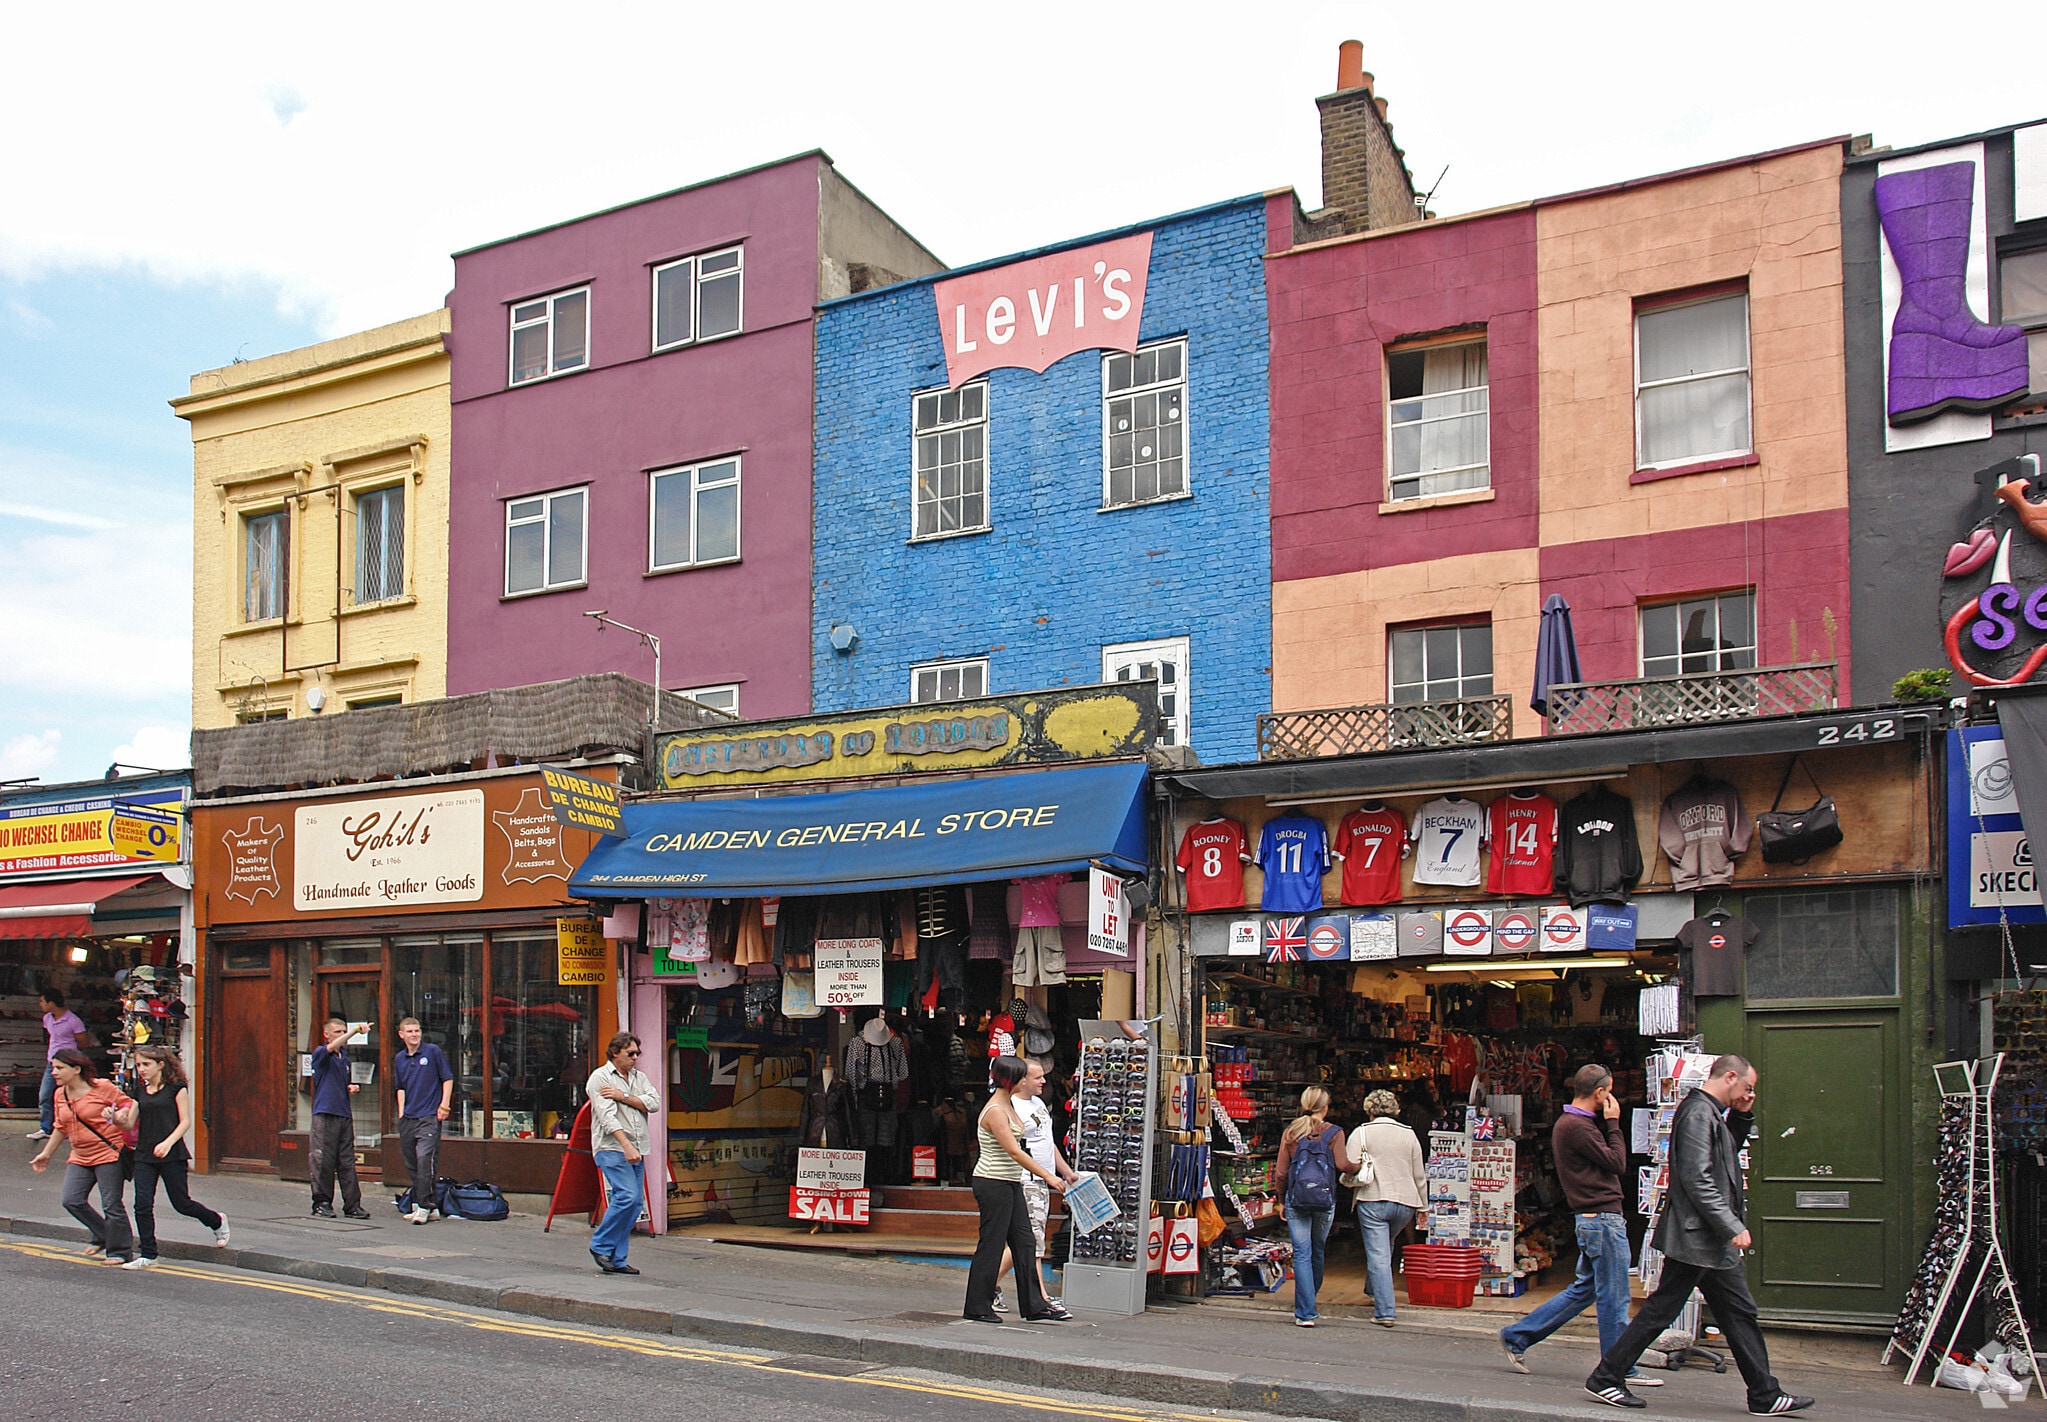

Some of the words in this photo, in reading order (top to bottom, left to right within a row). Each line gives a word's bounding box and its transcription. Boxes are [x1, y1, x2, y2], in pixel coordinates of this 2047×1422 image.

[1817, 718, 1896, 746] 242
[543, 769, 615, 802] BUREAU
[9, 809, 30, 818] BUREAU
[30, 808, 38, 816] DE
[37, 806, 60, 816] CHANGE
[64, 803, 85, 812] CHEQUE
[550, 791, 570, 806] DE
[573, 796, 621, 818] CHANGE
[509, 813, 557, 825] Handcrafte
[1508, 808, 1539, 819] HENRY
[1679, 804, 1726, 831] OXFORD
[115, 818, 142, 829] CAMBIO
[567, 809, 616, 831] CAMBIO
[1424, 815, 1478, 831] BECKHAM
[12, 822, 58, 847] WECHSEL
[61, 819, 103, 843] CHANGE
[115, 826, 148, 837] WECHSEL
[519, 825, 551, 836] Sandals
[645, 829, 772, 852] CAMDEN
[776, 818, 926, 847] GENERAL
[935, 804, 1060, 832] STORE
[1352, 825, 1393, 837] RONALDO
[1576, 819, 1615, 836] LONDON
[115, 833, 143, 843] CHANGE
[341, 806, 434, 862] Gohil's
[1275, 829, 1307, 842] DROGBA
[1505, 821, 1538, 856] 14
[237, 838, 269, 848] Makers
[1193, 834, 1231, 848] ROONEY
[1439, 828, 1464, 863] 7
[531, 849, 538, 857] &
[1276, 842, 1302, 874] 11
[1364, 837, 1383, 869] 7
[6, 858, 15, 870] &
[16, 856, 57, 869] Fashion
[236, 856, 268, 865] Quality
[386, 857, 402, 865] 1966
[514, 859, 555, 868] Accessories
[1203, 847, 1222, 878] 8
[235, 865, 269, 874] Leather
[1425, 861, 1466, 874] England
[234, 874, 271, 882] Products
[589, 874, 611, 882] 244
[612, 874, 663, 883] CAMDEN
[661, 874, 689, 882] HIGH
[689, 873, 708, 882] ST
[302, 881, 371, 901] Handmade
[377, 877, 428, 901] Leather
[435, 873, 476, 892] Goods
[1102, 874, 1120, 900] UNIT
[1107, 899, 1115, 913] TO
[560, 922, 604, 934] BUREAU
[1103, 913, 1118, 937] LET
[575, 935, 588, 945] DE
[817, 941, 836, 950] MORE
[838, 940, 857, 949] LONG
[1089, 933, 1102, 947] 020
[1102, 936, 1115, 950] 7267
[561, 946, 605, 957] CHANGE
[562, 961, 571, 970] NO
[661, 959, 674, 972] TO
[677, 959, 696, 971] LET
[817, 960, 844, 969] LEATHER
[846, 959, 880, 969] TROUSERS
[561, 972, 605, 982] CAMBIO
[838, 972, 859, 981] INSIDE
[827, 992, 853, 1004] 50%
[801, 1150, 820, 1159] MORE
[822, 1151, 841, 1160] LONG
[842, 1152, 864, 1161] COATS
[1809, 1164, 1833, 1175] 242
[799, 1170, 827, 1180] LEATHER
[829, 1171, 862, 1182] TROUSERS
[820, 1181, 840, 1190] INSIDE
[796, 1189, 838, 1198] CLOSING
[840, 1190, 870, 1198] DOWN
[795, 1197, 870, 1222] SALE
